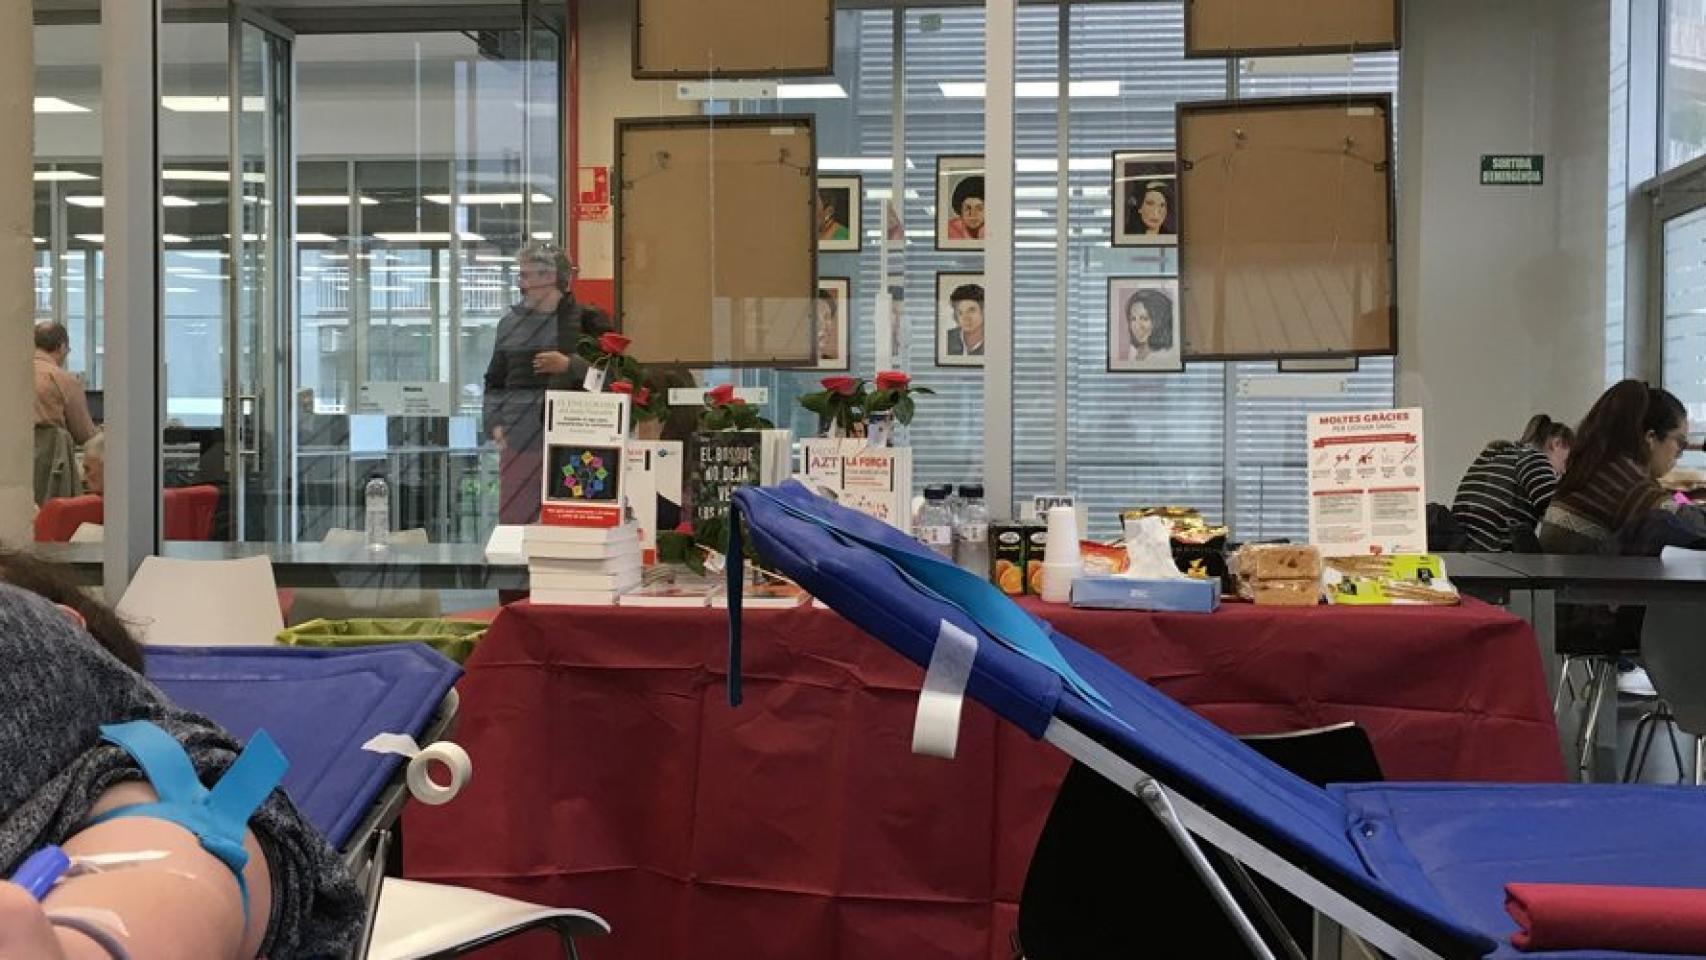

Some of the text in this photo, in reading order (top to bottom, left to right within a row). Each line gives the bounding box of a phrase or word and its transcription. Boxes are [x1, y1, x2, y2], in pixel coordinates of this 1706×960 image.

[1492, 157, 1532, 170] SORTIDA
[1319, 411, 1409, 424] MOLTES GRÀCIES
[700, 446, 753, 462] EL BOSQUE
[846, 456, 888, 468] LA FORÇA
[705, 466, 719, 481] NO
